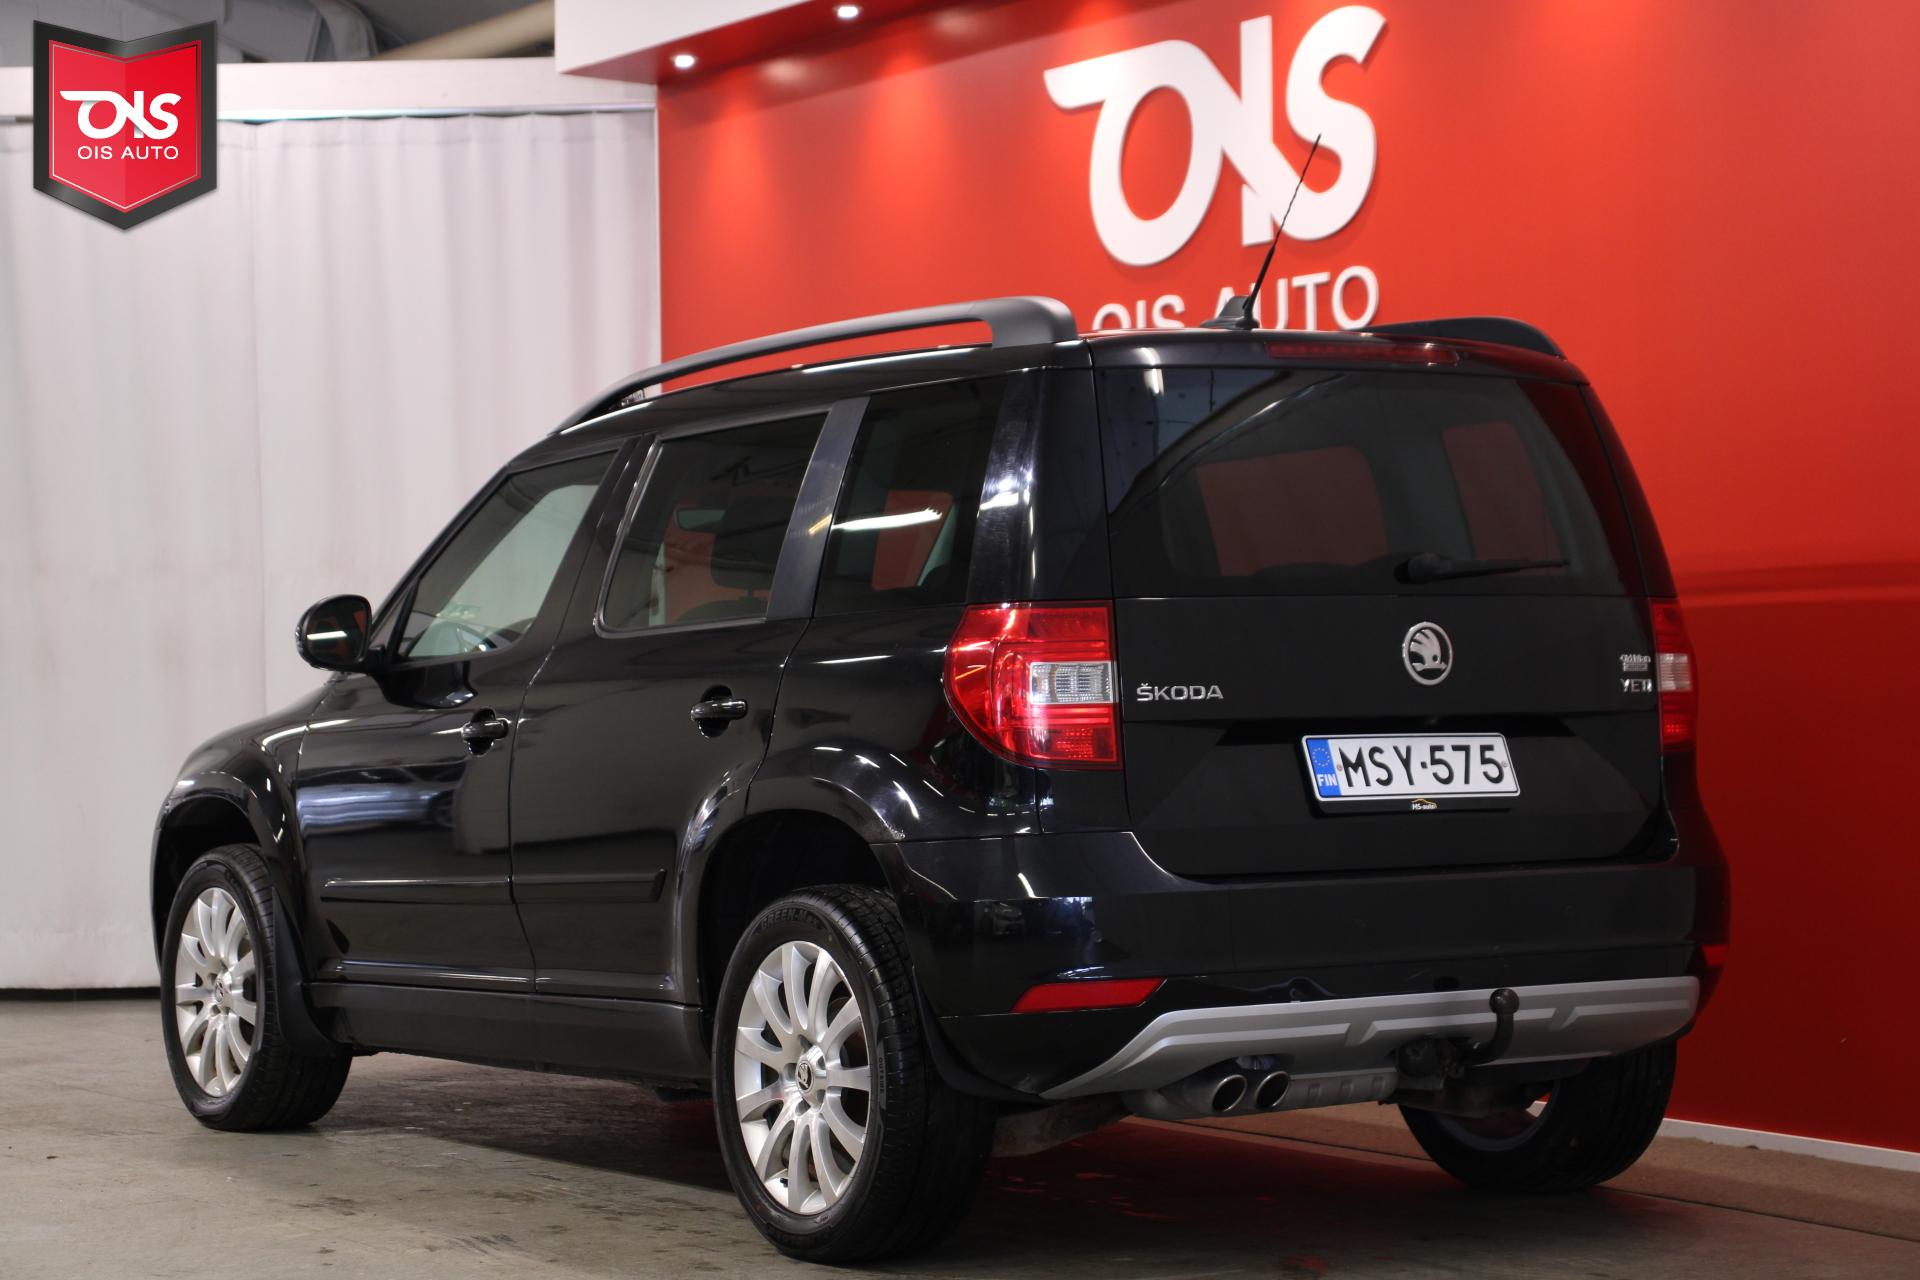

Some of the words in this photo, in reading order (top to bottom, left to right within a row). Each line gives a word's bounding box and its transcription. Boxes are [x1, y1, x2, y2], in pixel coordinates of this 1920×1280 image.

[1043, 5, 1386, 266] OIS
[1137, 683, 1224, 701] ŠKODA
[1316, 774, 1338, 787] FIN
[1338, 744, 1504, 787] MSY-575
